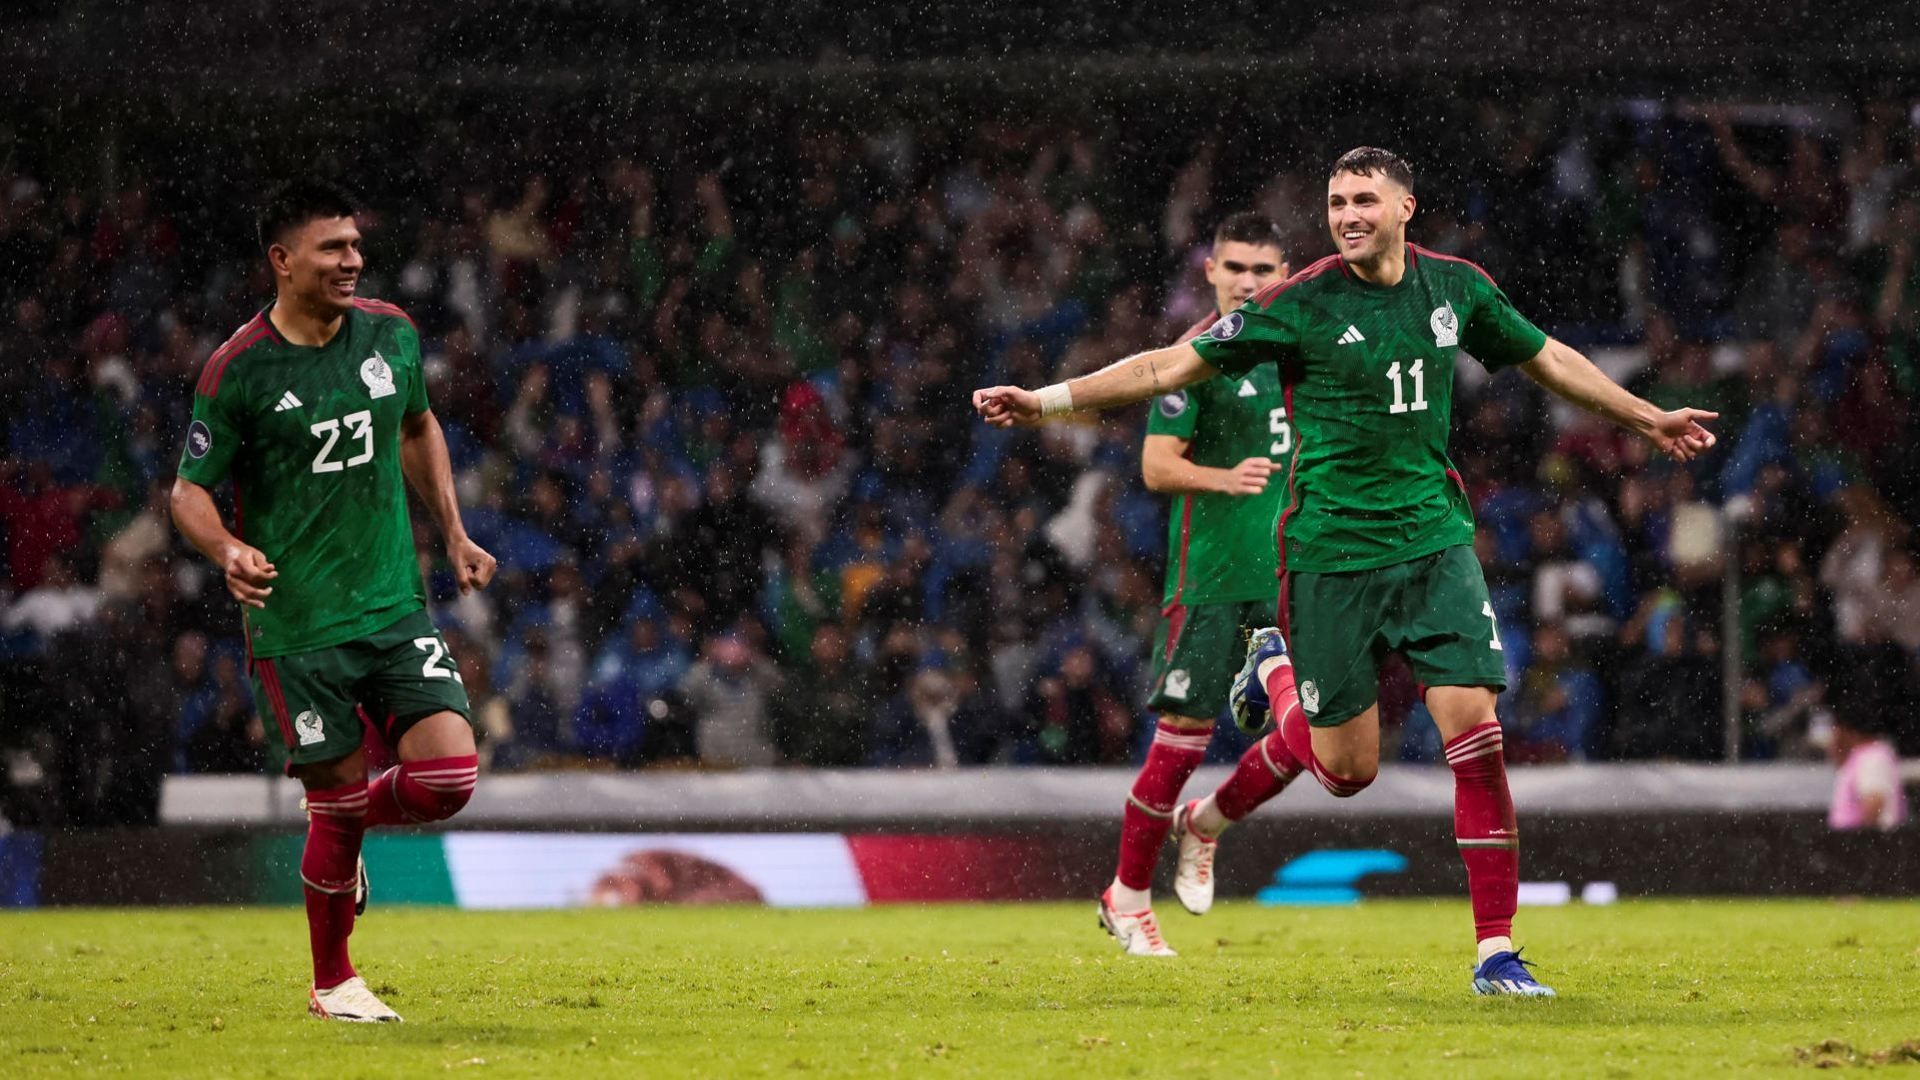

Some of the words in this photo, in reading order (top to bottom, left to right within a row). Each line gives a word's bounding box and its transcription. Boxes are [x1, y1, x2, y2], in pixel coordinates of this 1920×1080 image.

[1386, 359, 1428, 414] 11
[311, 410, 374, 473] 23
[1269, 406, 1291, 455] 5
